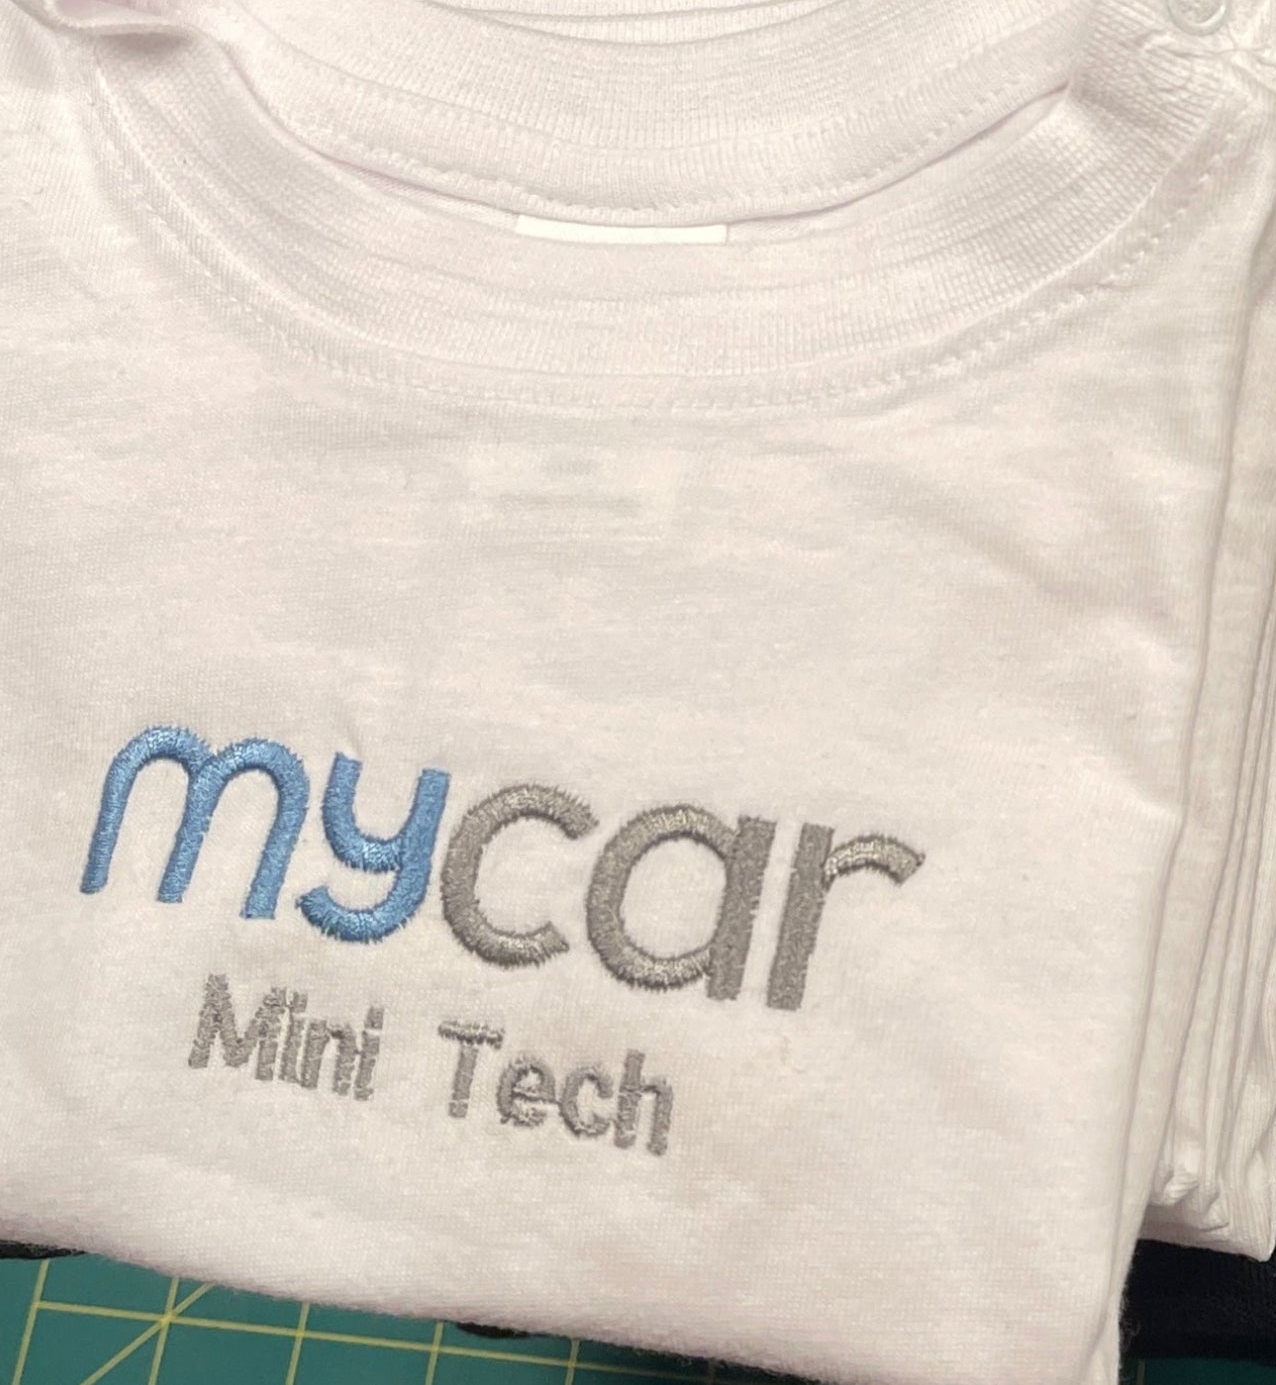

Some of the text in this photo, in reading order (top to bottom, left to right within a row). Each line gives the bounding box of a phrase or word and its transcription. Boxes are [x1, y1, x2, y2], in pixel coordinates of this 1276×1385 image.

[81, 725, 926, 1011] mycar
[188, 973, 676, 1157] Mini Tech
